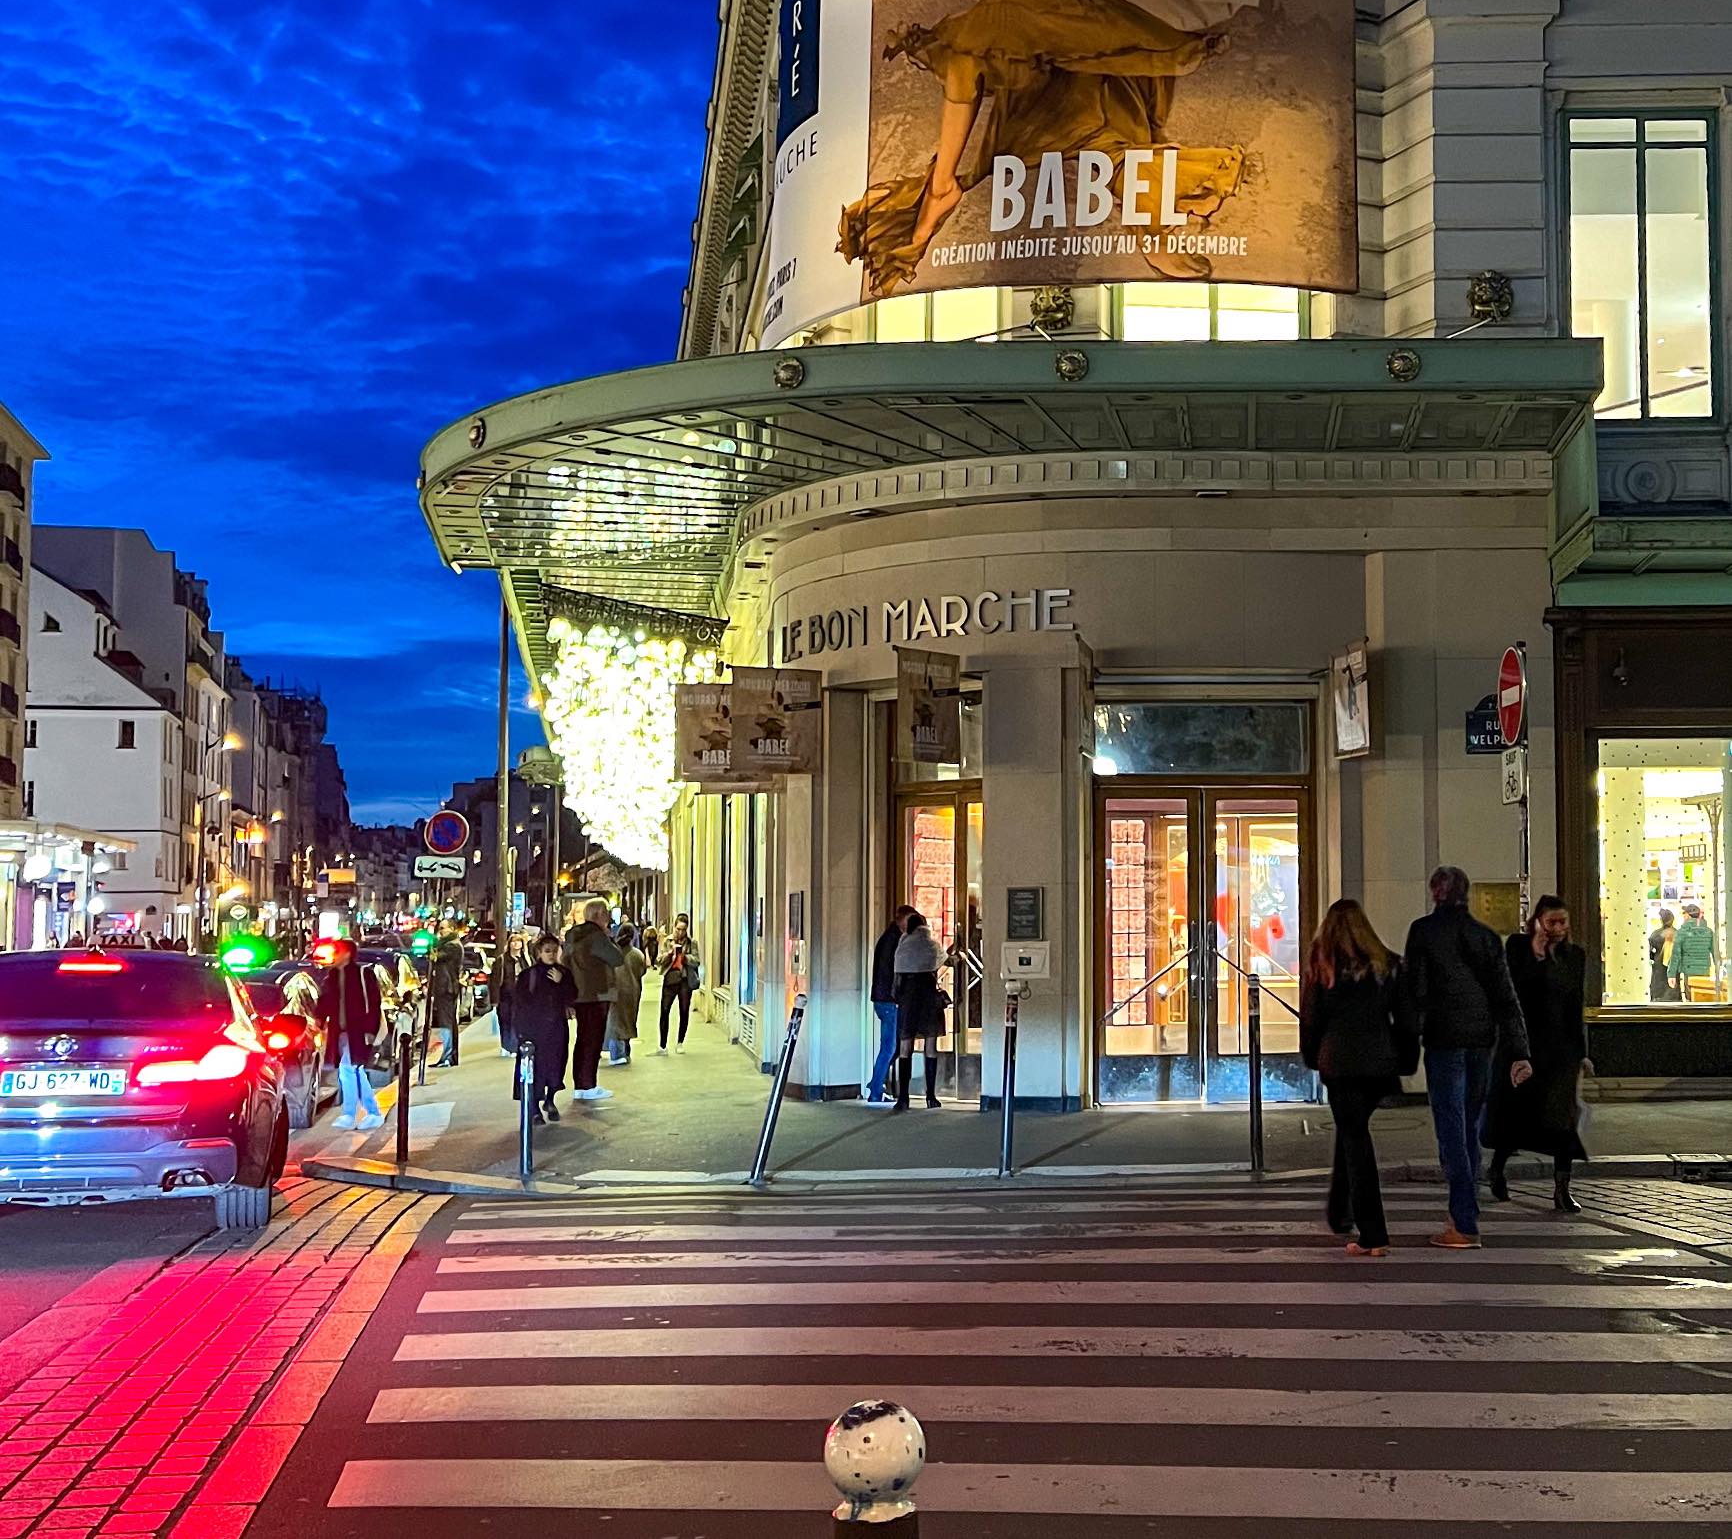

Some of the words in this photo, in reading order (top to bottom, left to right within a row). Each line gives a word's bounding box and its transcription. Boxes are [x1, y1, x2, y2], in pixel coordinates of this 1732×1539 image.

[989, 149, 1189, 233] BABEL
[931, 241, 996, 267] CRÉATION
[1000, 236, 1056, 259] INÉDITE
[1061, 235, 1137, 257] JUSQU'AU
[1142, 235, 1160, 254] 31
[1166, 233, 1248, 256] DÉCEMBRE
[782, 620, 803, 664] LE
[808, 606, 868, 655] BON
[882, 589, 1075, 643] MARCHE
[1486, 721, 1501, 731] RU
[757, 738, 791, 755] BABEL
[702, 749, 731, 765] BABE
[100, 935, 136, 945] TAXI
